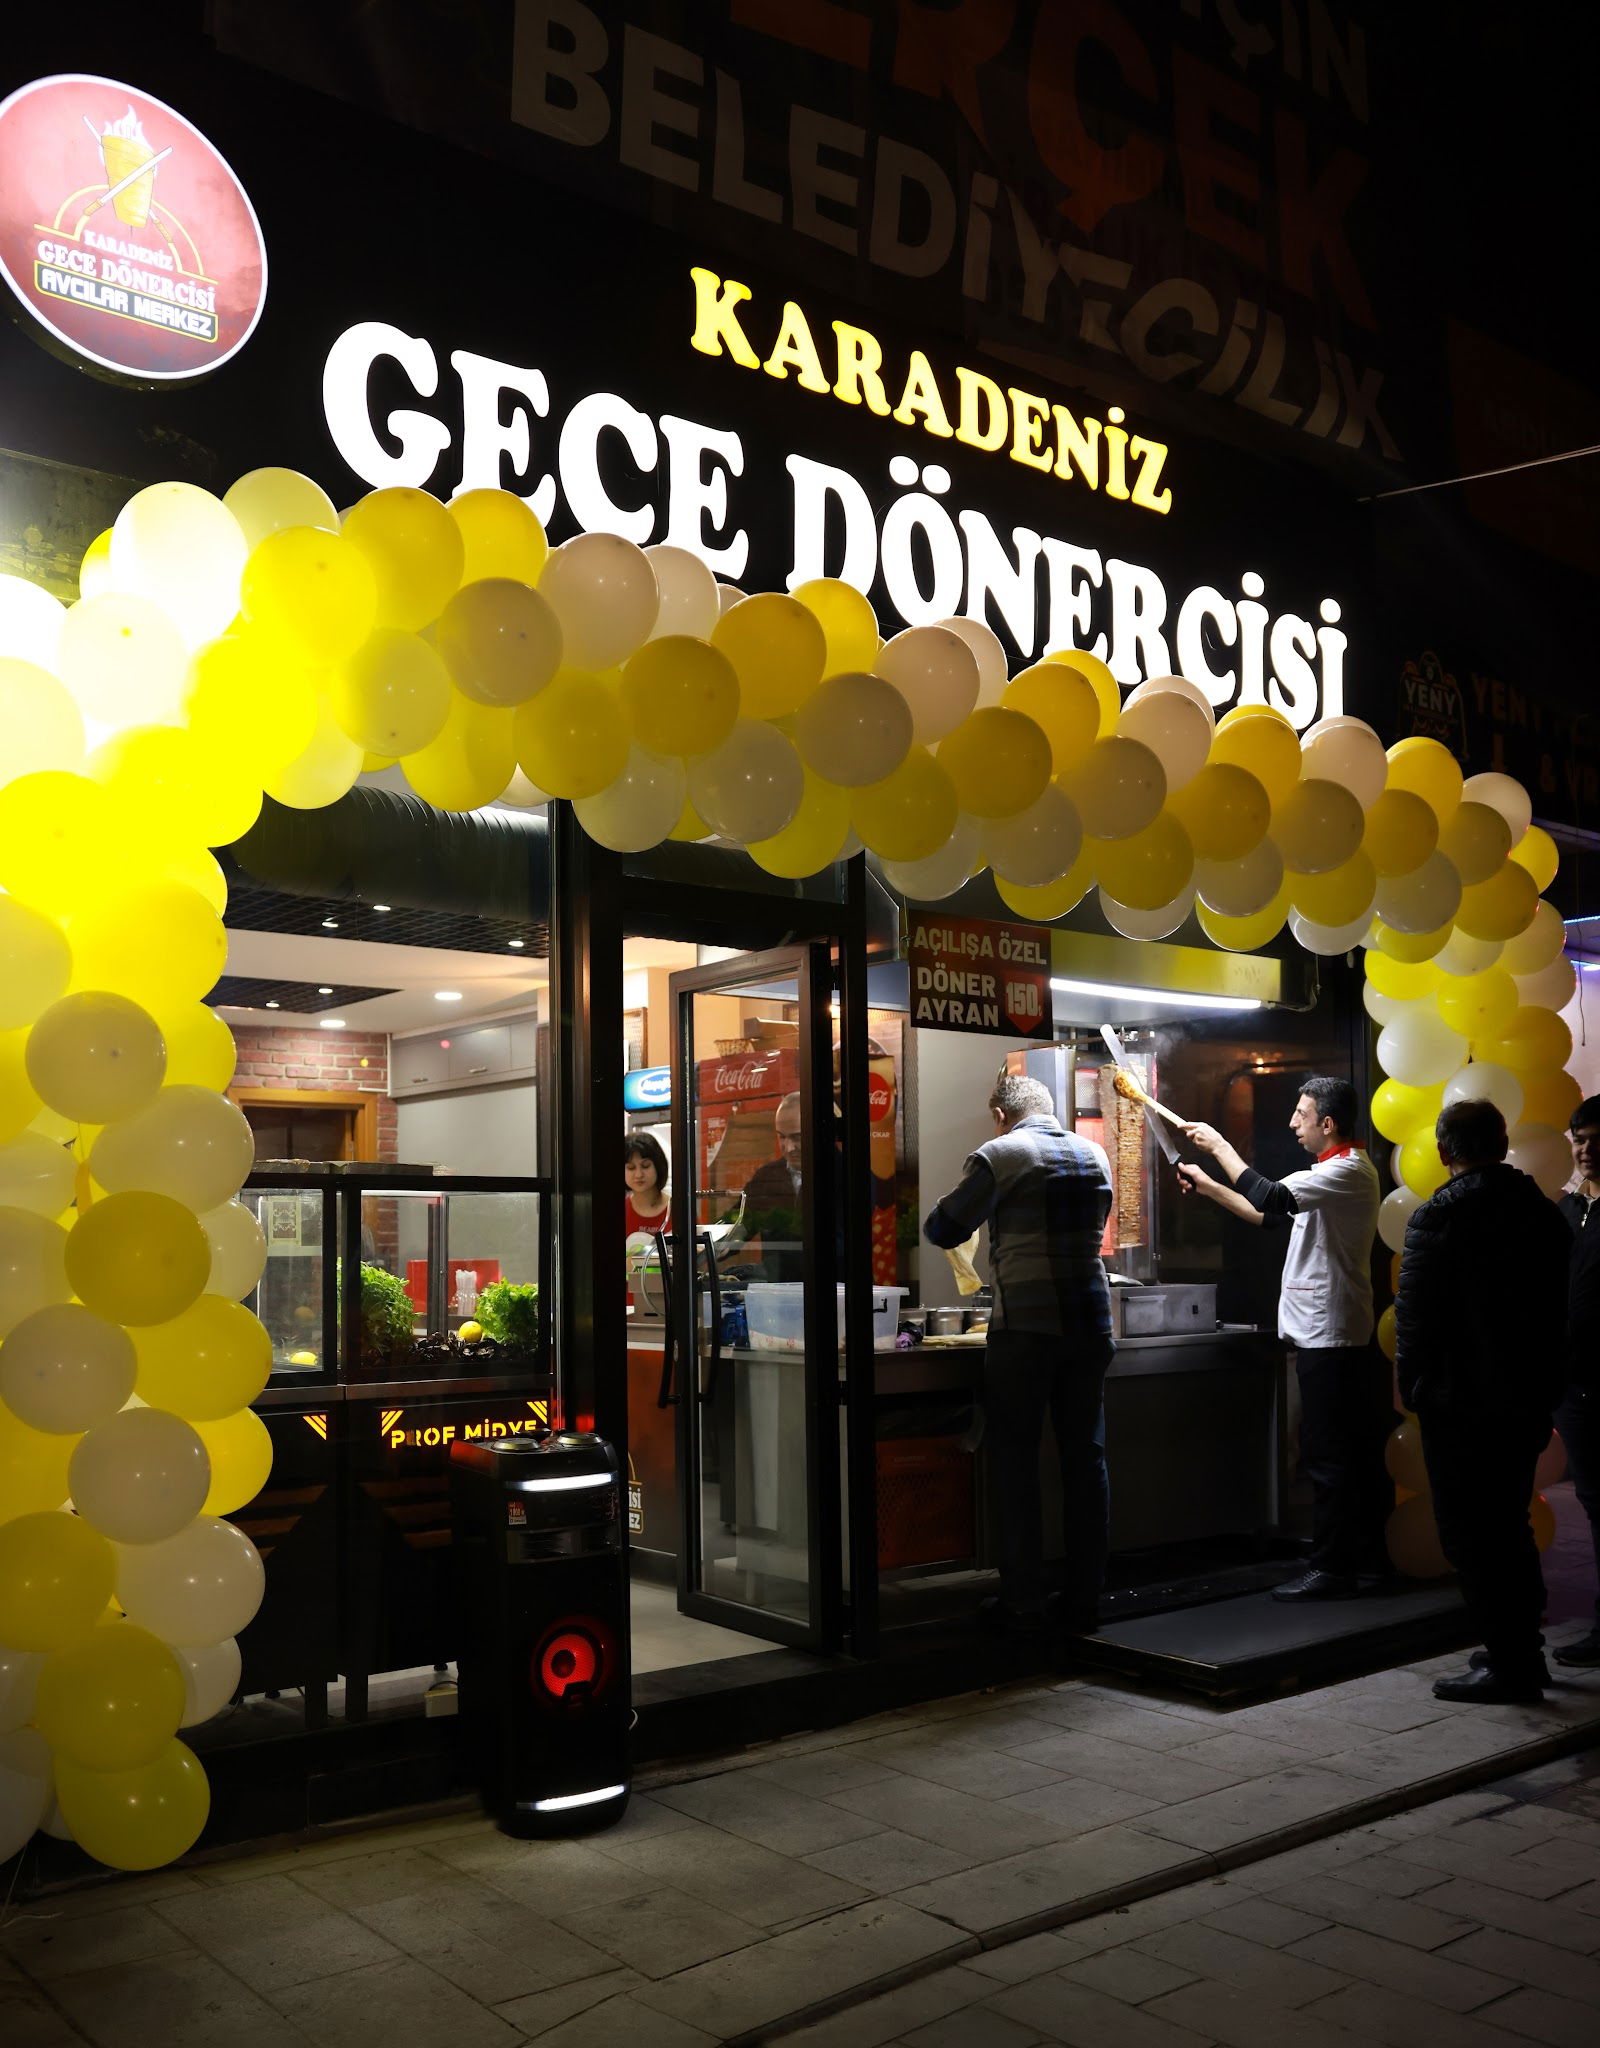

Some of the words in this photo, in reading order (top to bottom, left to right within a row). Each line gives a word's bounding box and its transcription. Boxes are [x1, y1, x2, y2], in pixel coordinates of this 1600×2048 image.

[84, 230, 174, 270] KARADENİZ
[37, 240, 97, 277] GECE
[102, 258, 216, 312] DÖNERCİSİ
[41, 268, 129, 313] AVCILAR
[134, 296, 212, 337] MERKEZ
[690, 266, 1172, 515] KARADENİZ
[322, 321, 749, 580] GECE
[785, 455, 1347, 730] DÖNERCİSİ
[1404, 679, 1457, 717] YENY
[913, 926, 995, 960] AÇILIŞA
[998, 930, 1047, 965] ÖZEL
[917, 962, 996, 998] DÖNER
[916, 996, 999, 1028] AYRAN
[391, 1425, 456, 1449] PROF
